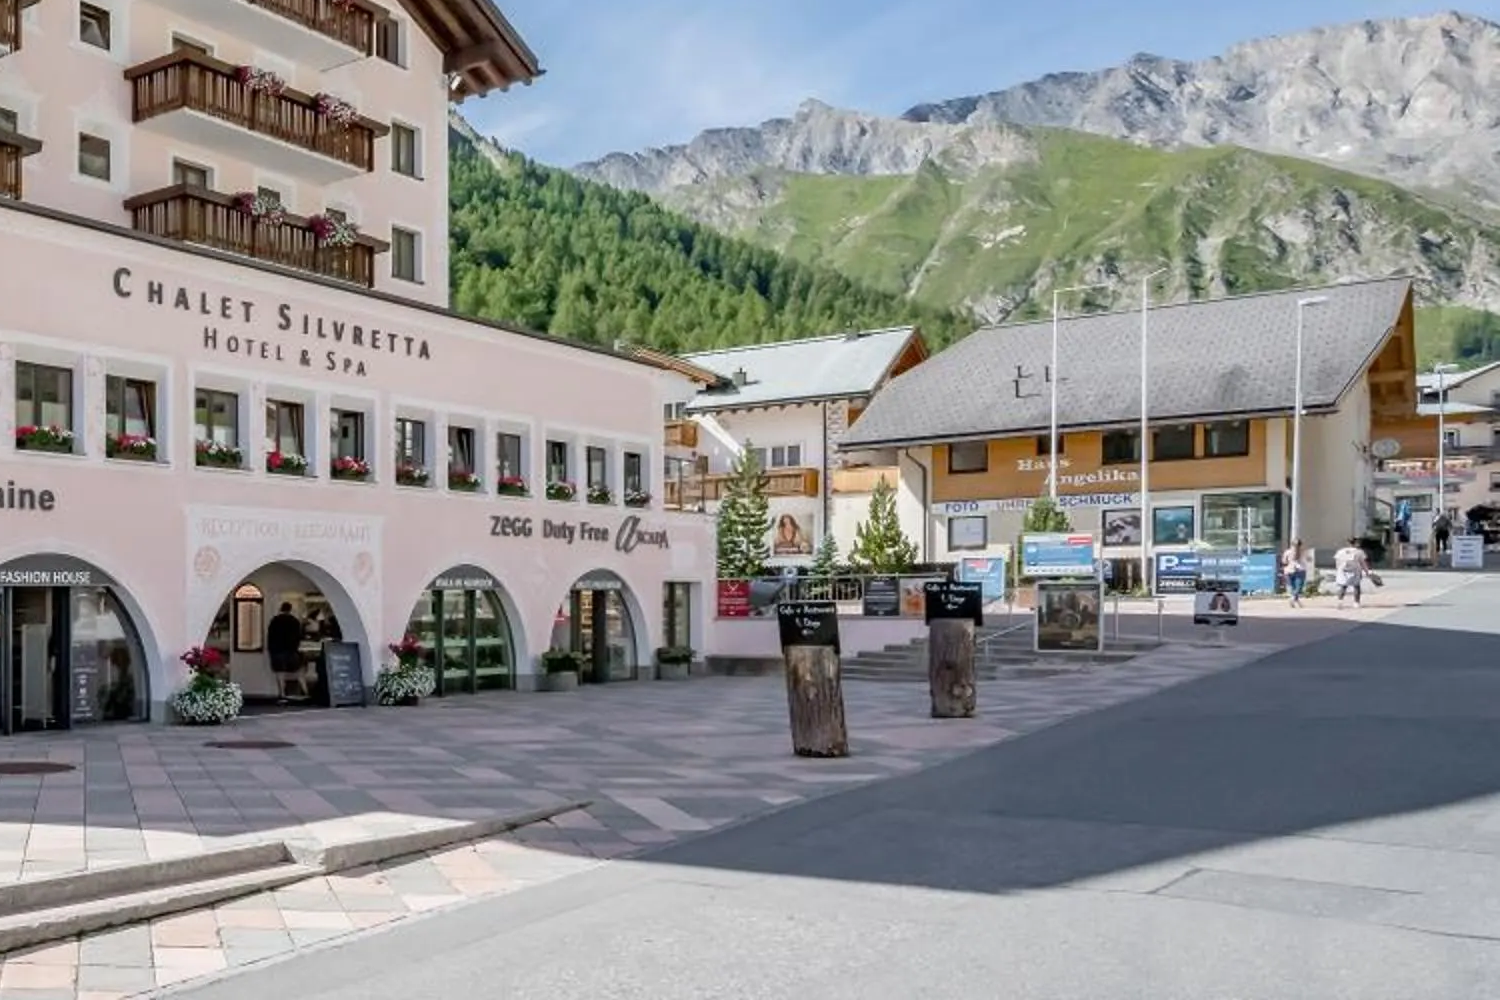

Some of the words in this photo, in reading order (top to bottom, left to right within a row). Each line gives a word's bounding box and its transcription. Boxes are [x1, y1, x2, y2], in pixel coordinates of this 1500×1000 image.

[113, 267, 254, 323] CHALET
[278, 303, 431, 360] SILVRETTA
[204, 327, 284, 361] HOTEL
[299, 349, 312, 366] &
[327, 351, 367, 377] SPA
[1017, 458, 1072, 471] Has
[945, 501, 979, 513] FOTO
[1058, 494, 1133, 508] SCHMUCK
[542, 519, 576, 545] Duty
[579, 521, 609, 542] Free
[1160, 555, 1179, 571] P
[0, 570, 51, 584] FASHION
[53, 571, 91, 585] HOUSE
